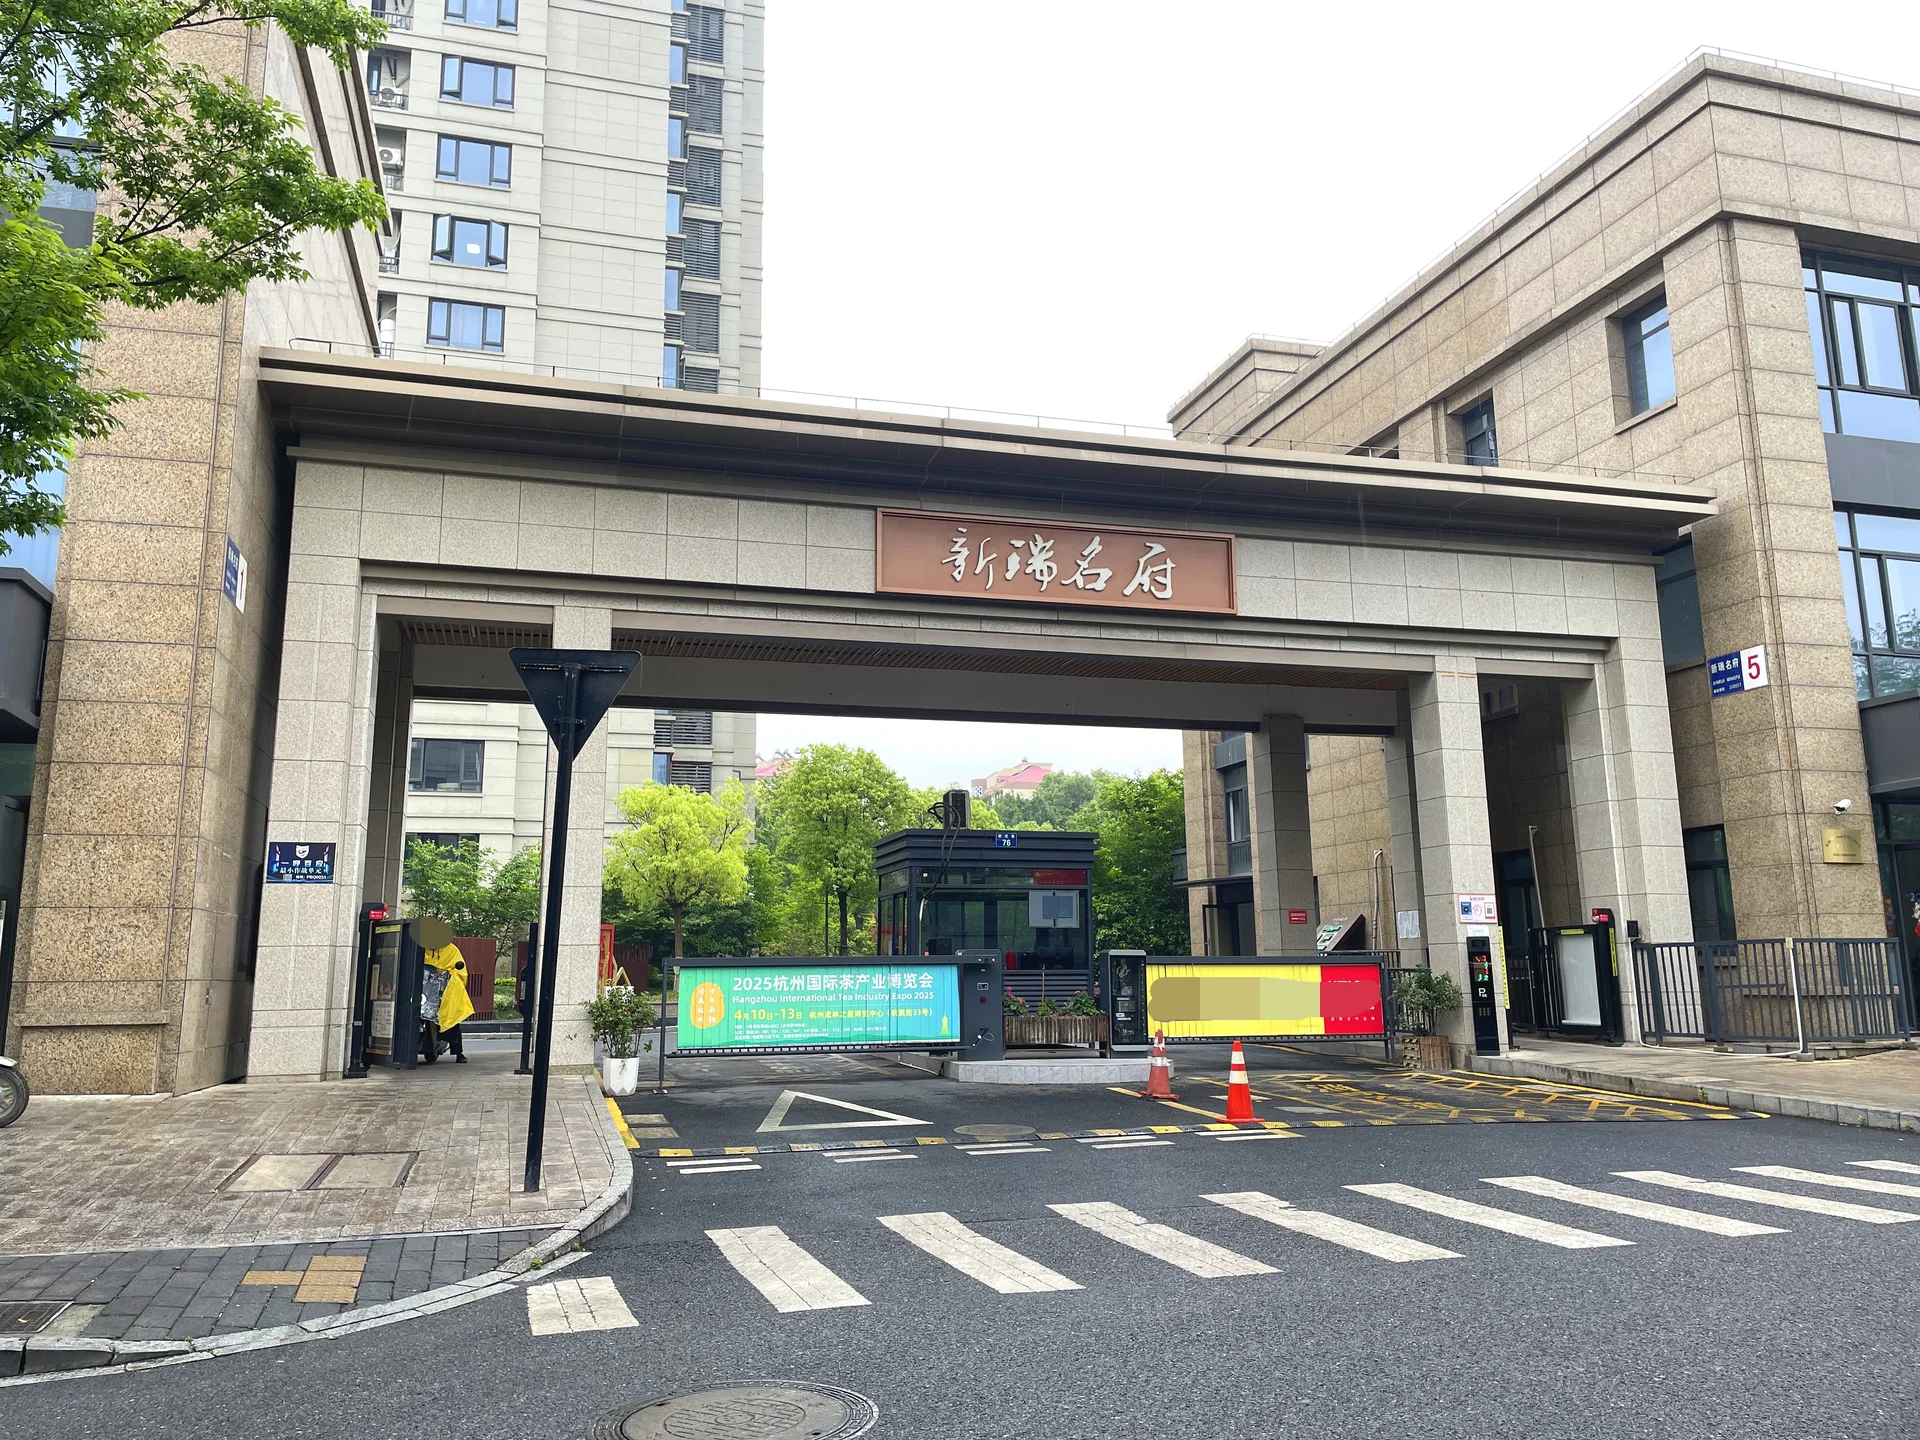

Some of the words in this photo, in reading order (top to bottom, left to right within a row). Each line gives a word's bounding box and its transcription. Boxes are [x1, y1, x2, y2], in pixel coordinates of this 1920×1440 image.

[941, 527, 1177, 600] 新瑞名府
[240, 569, 245, 600] 1
[1711, 657, 1739, 674] 新瑞名府
[1747, 654, 1761, 680] 5
[1002, 839, 1011, 847] 76
[733, 972, 934, 992] 2025杭州国际茶产业博览会
[732, 995, 778, 1005] Hangzhou
[779, 994, 836, 1003] International
[838, 993, 853, 1002] Tea
[854, 992, 890, 1003] Industry
[892, 992, 912, 1002] Expo
[914, 991, 935, 1000] 2025
